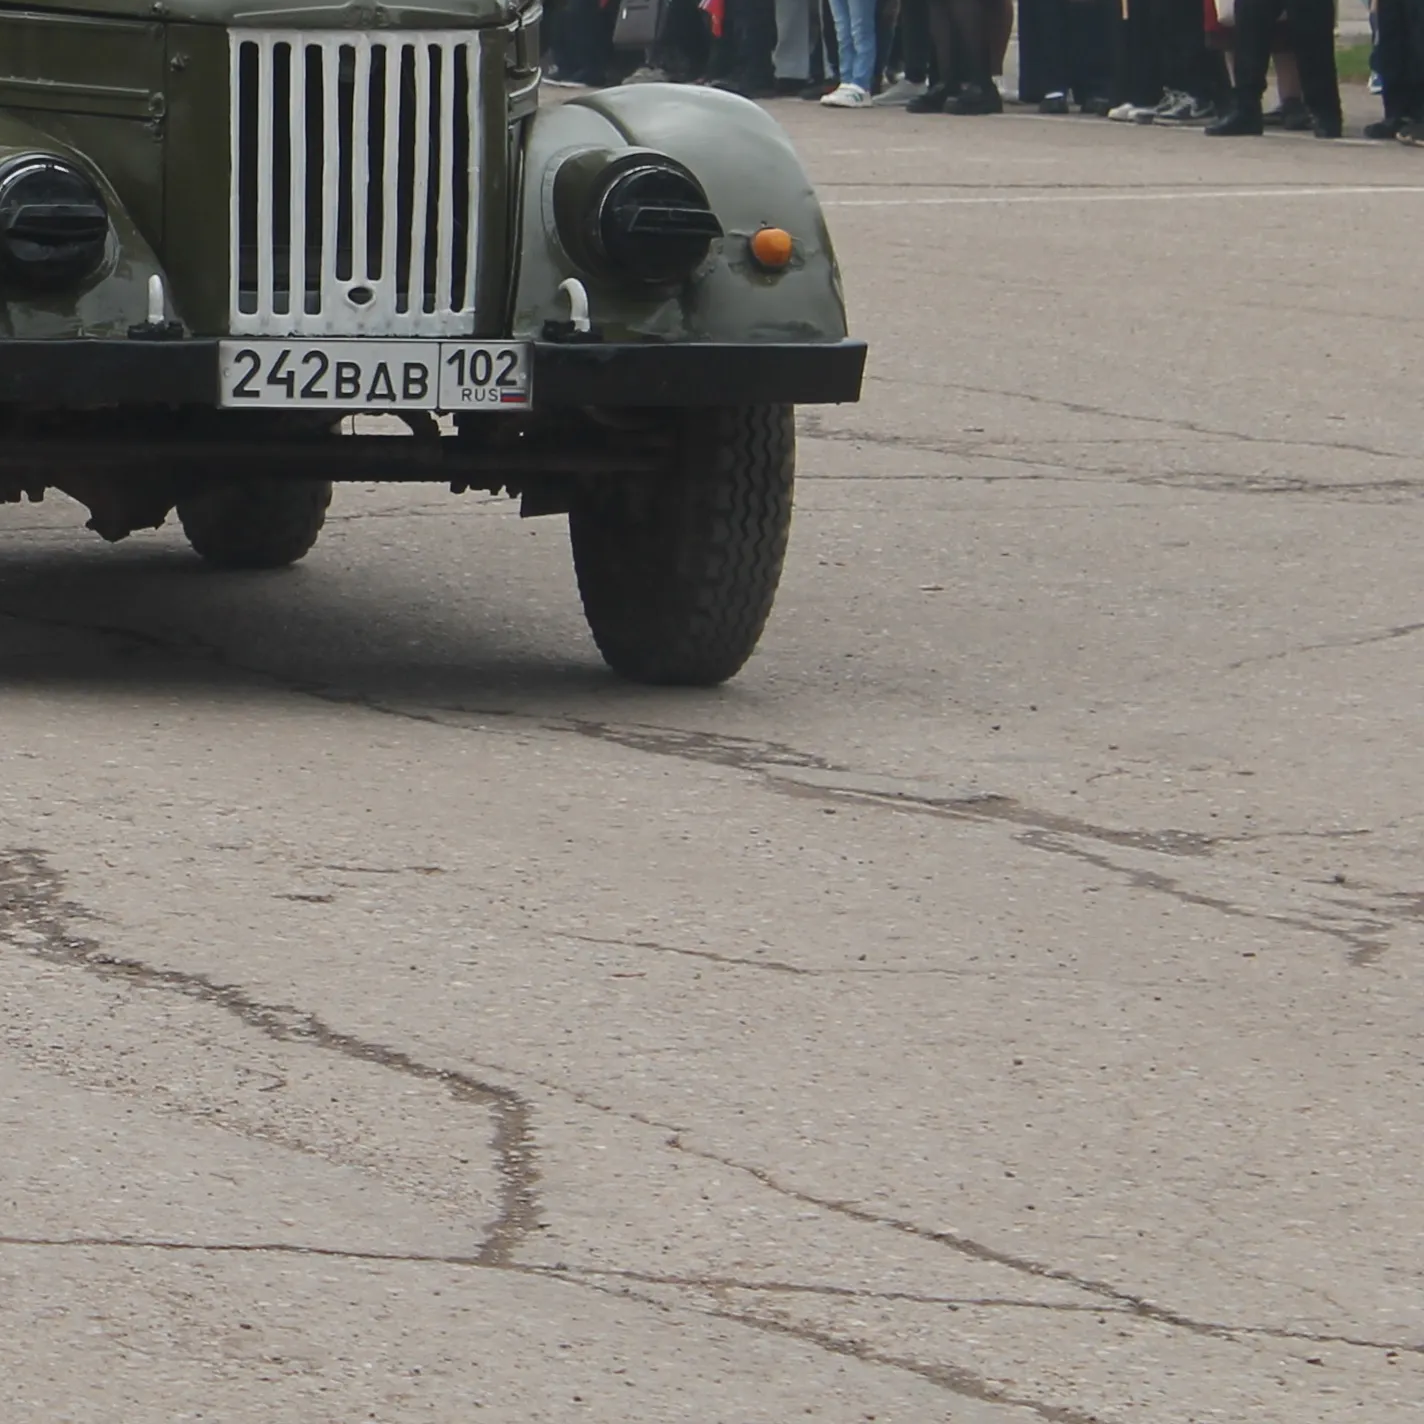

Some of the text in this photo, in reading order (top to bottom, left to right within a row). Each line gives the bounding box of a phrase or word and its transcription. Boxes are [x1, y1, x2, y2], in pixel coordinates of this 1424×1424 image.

[232, 349, 519, 402] 242ВДВ 102
[461, 387, 498, 402] RUS
